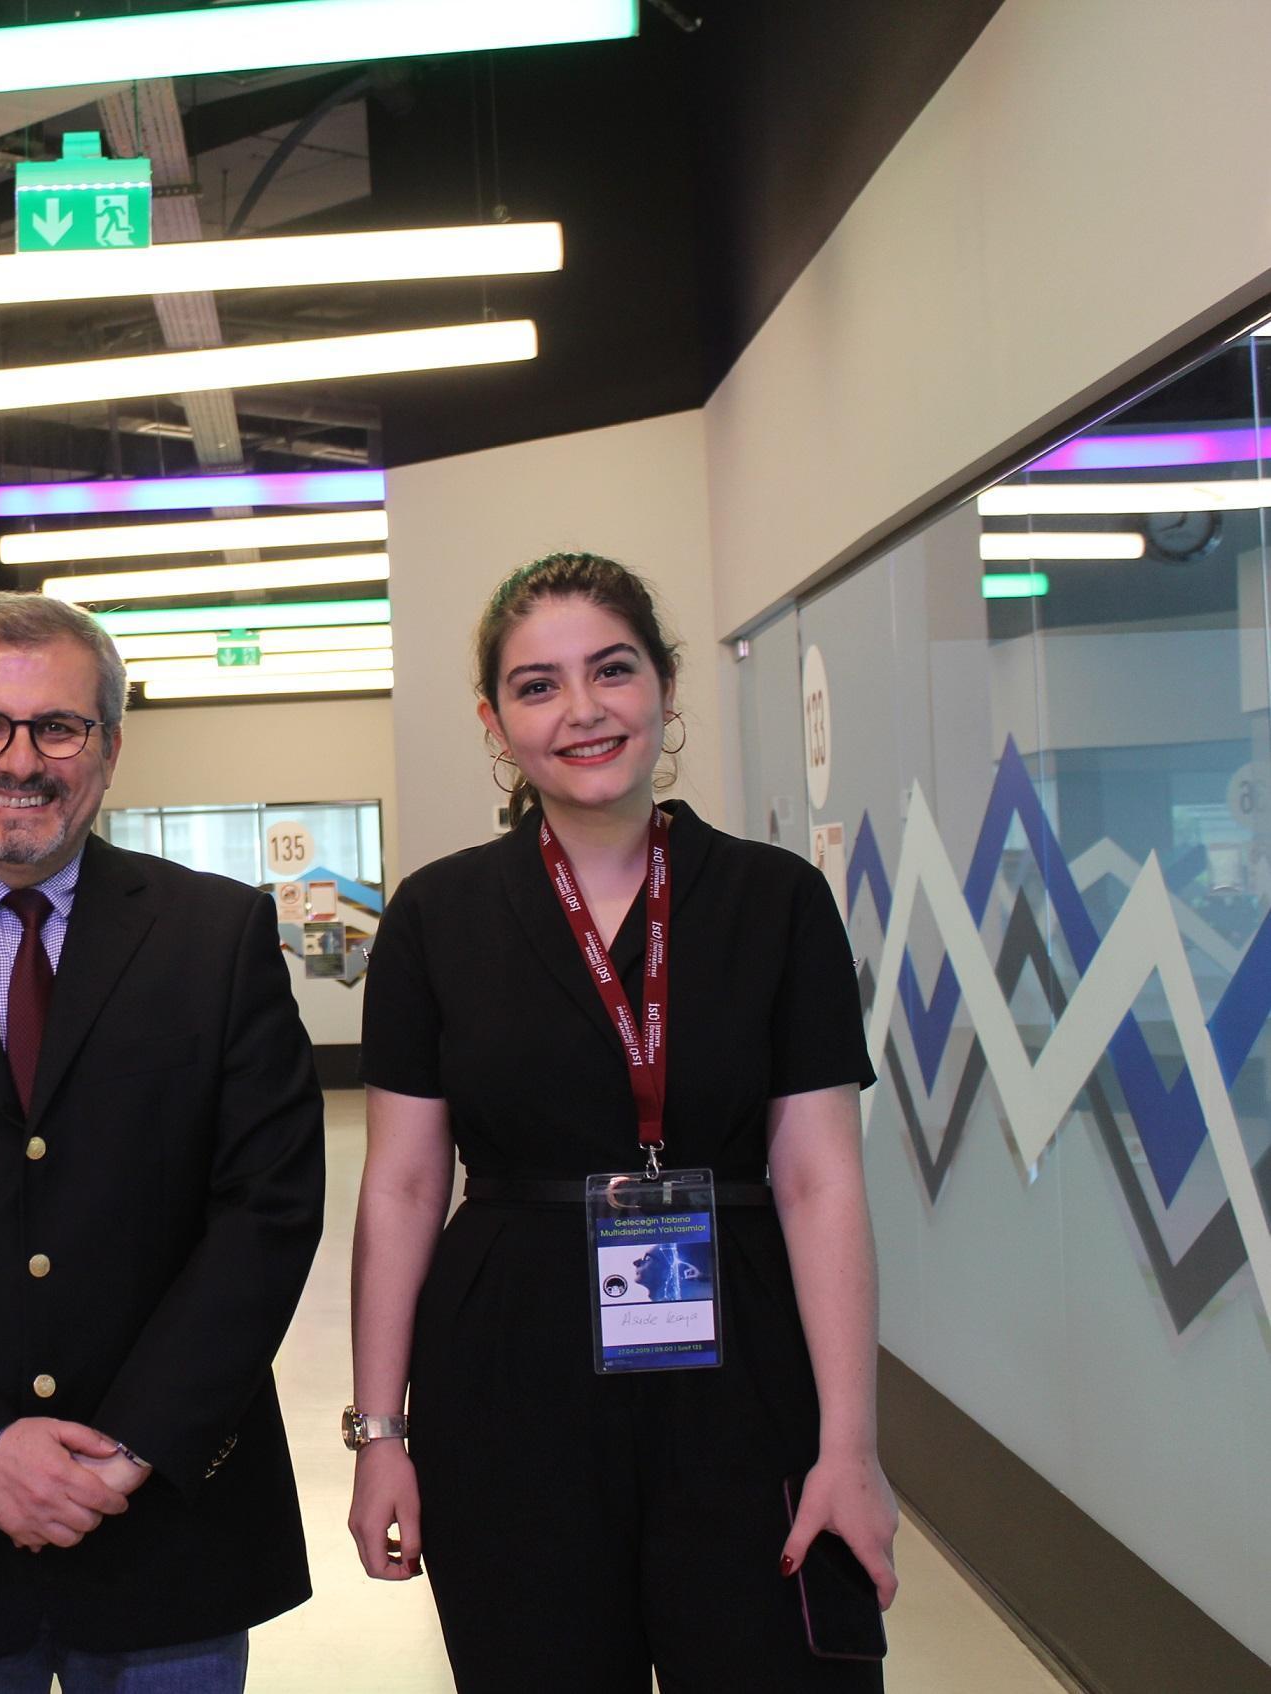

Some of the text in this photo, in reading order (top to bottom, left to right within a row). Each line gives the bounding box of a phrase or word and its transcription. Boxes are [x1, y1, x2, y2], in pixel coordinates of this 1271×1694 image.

[271, 835, 305, 861] 135
[653, 846, 663, 862] İSÜ
[564, 894, 580, 912] İSÜ
[651, 921, 662, 938] İSÜ
[595, 965, 612, 983] İSÜ
[648, 1002, 660, 1020] İSÜ
[628, 1046, 643, 1065] İSÜ
[615, 1217, 658, 1226] Geleceğin
[600, 1228, 656, 1236] Multidisipliner
